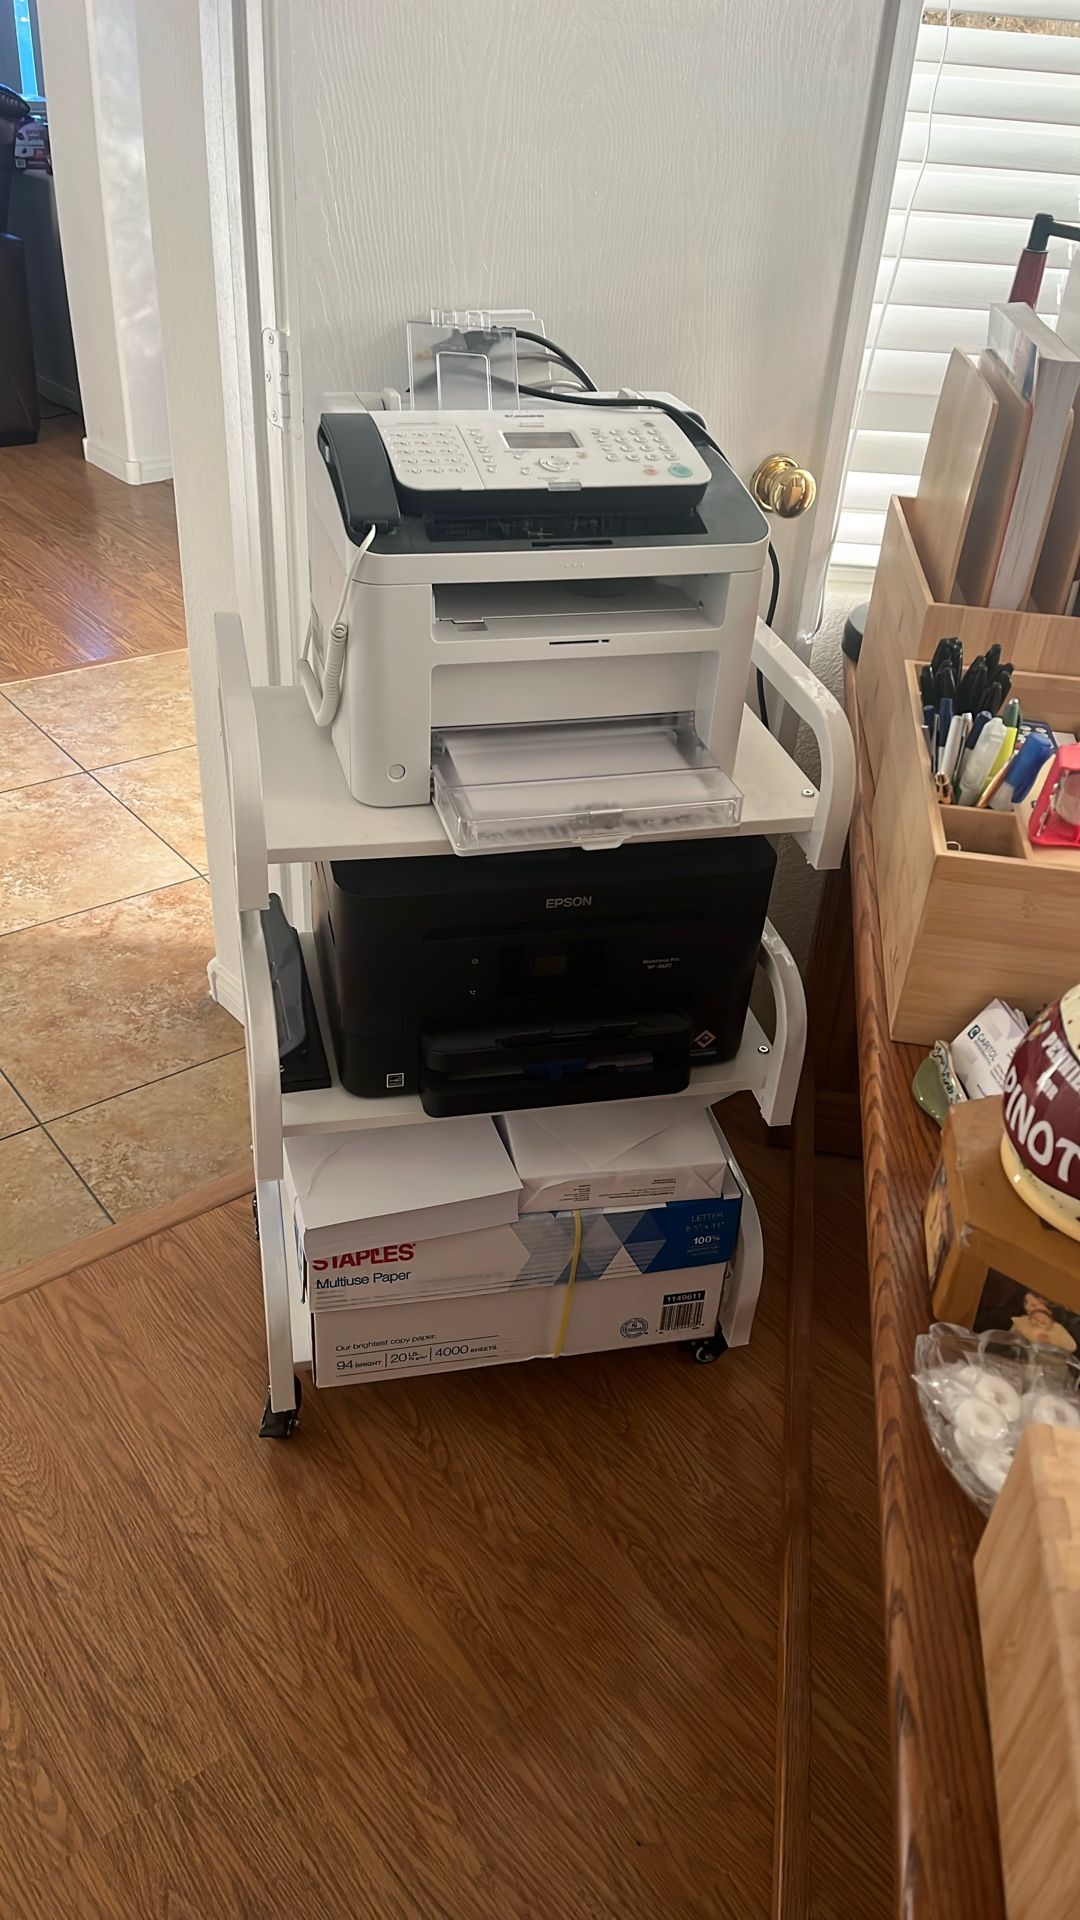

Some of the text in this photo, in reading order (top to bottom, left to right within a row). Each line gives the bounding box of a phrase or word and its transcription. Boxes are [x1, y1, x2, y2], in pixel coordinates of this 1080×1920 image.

[545, 896, 593, 909] EPSON
[1004, 1065, 1080, 1184] PINOT
[691, 1212, 724, 1222] LETTER
[312, 1243, 415, 1271] STAPLES
[316, 1271, 412, 1290] Multiuse Paper
[353, 1339, 388, 1350] brightest
[390, 1337, 411, 1345] copy
[336, 1360, 353, 1370] 94
[355, 1360, 382, 1369] BRIGHT
[390, 1352, 408, 1364] 20
[434, 1345, 469, 1357] 4000
[470, 1345, 497, 1353] SHEETS
